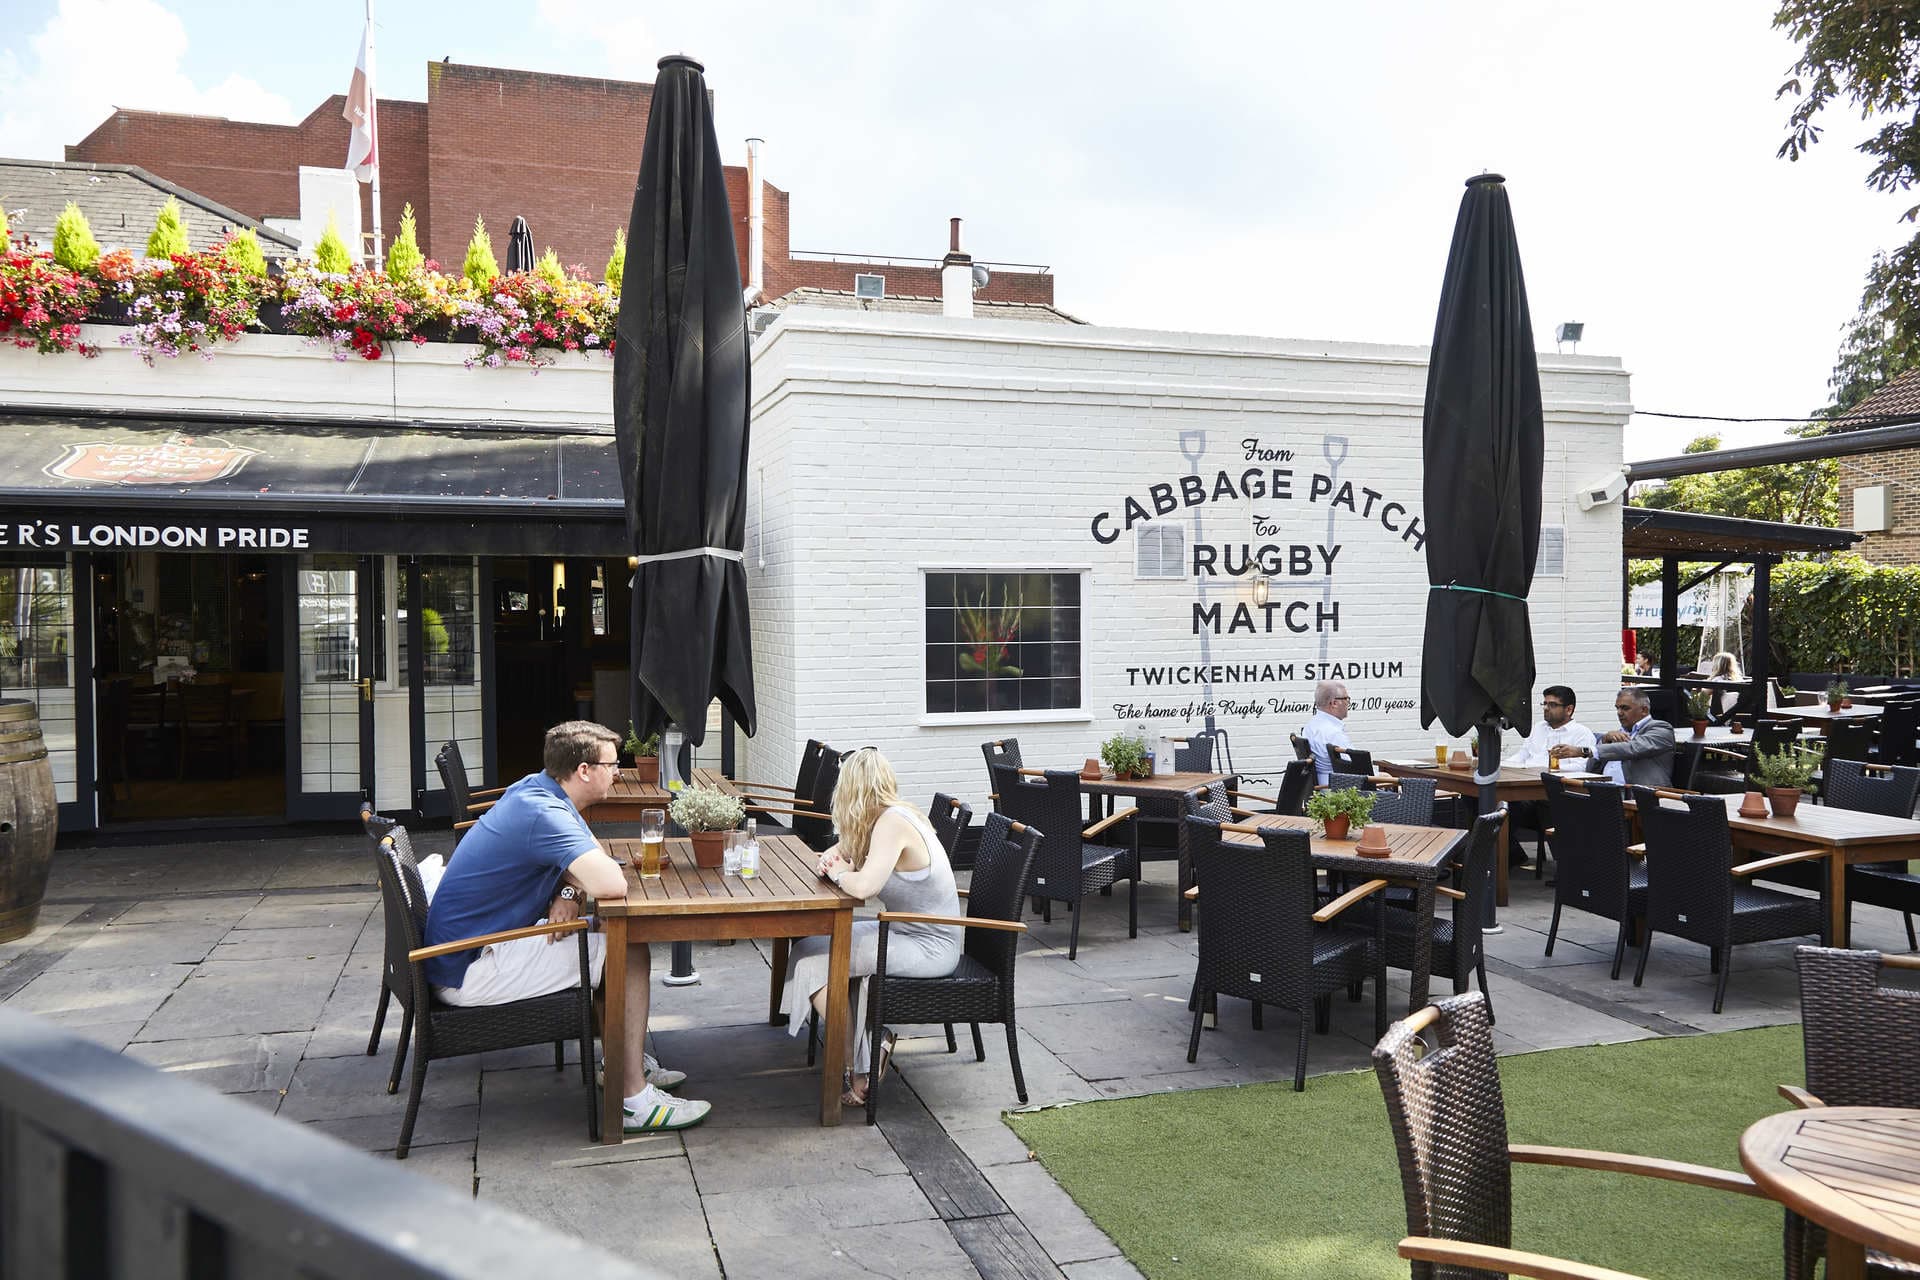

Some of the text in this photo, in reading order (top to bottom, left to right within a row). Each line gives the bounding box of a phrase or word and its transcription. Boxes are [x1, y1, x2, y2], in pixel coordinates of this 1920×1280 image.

[1241, 438, 1294, 462] From
[1091, 468, 1425, 551] CABBAGE PATCH
[72, 525, 207, 547] LONDON
[218, 527, 309, 548] PRIDE
[1252, 514, 1281, 537] To
[1193, 544, 1342, 577] RUGBY
[1192, 601, 1339, 635] MATCH
[1126, 661, 1403, 686] TWICKENHAM STADIUM
[1113, 703, 1143, 720] The
[1144, 702, 1179, 718] home
[1180, 701, 1195, 723] of
[1196, 702, 1216, 717] the
[1217, 699, 1266, 720] Rugby
[1267, 698, 1310, 714] Union
[1361, 696, 1382, 711] 100
[1384, 699, 1416, 714] years
